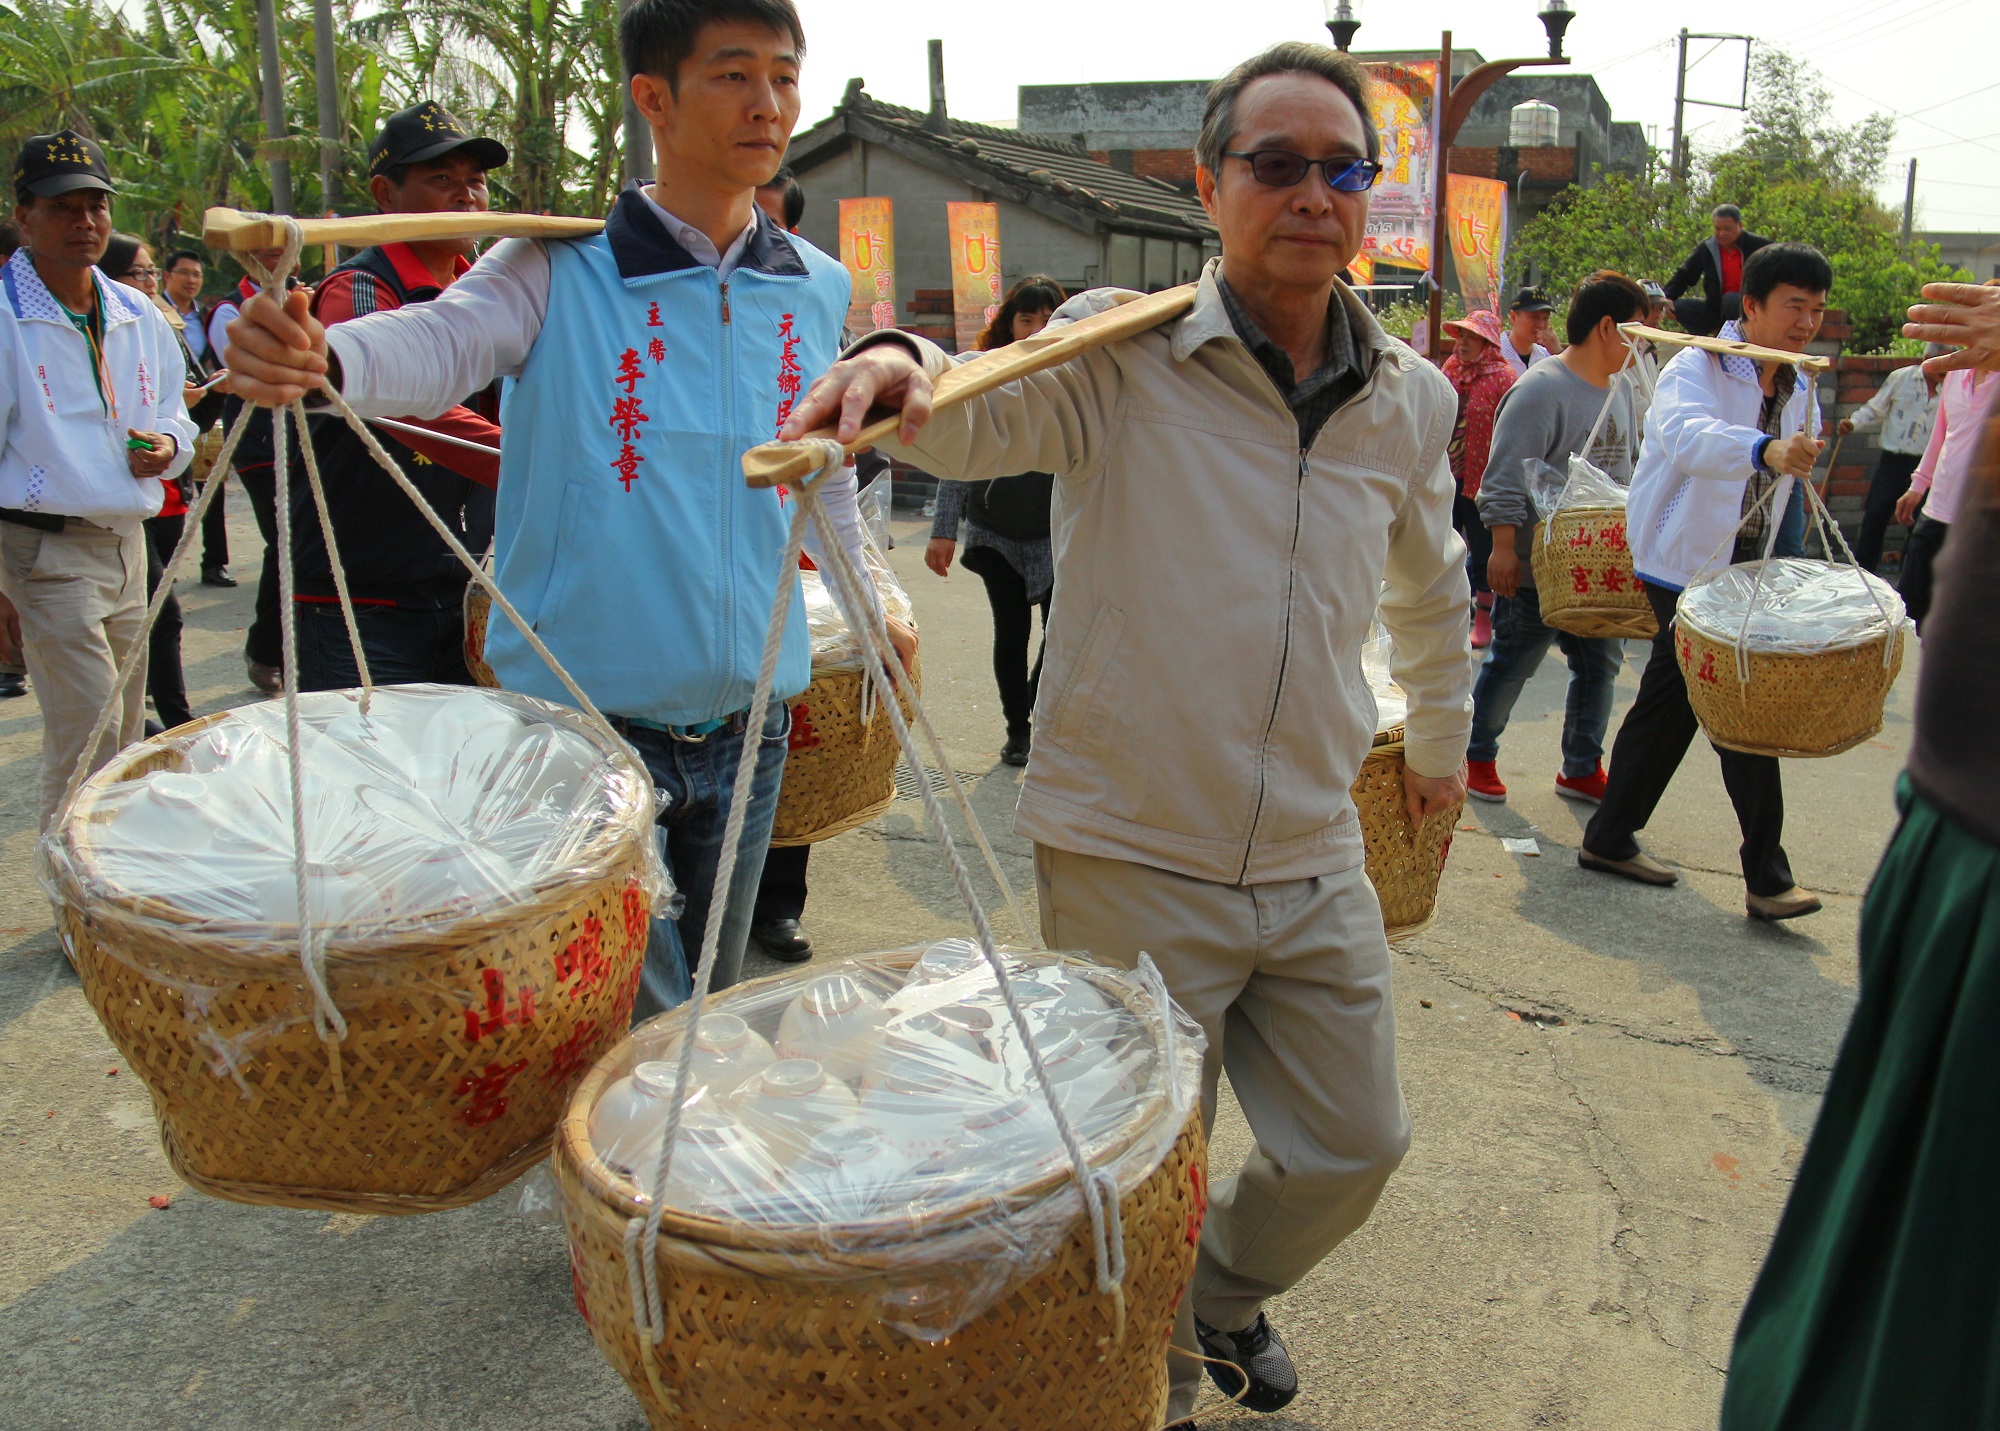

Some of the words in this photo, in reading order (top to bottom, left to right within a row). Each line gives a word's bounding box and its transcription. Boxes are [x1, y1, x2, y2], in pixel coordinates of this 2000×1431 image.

[1388, 98, 1417, 185] 來月眉
[1362, 222, 1392, 236] 015
[646, 301, 667, 366] 主席
[609, 347, 649, 493] 李榮章
